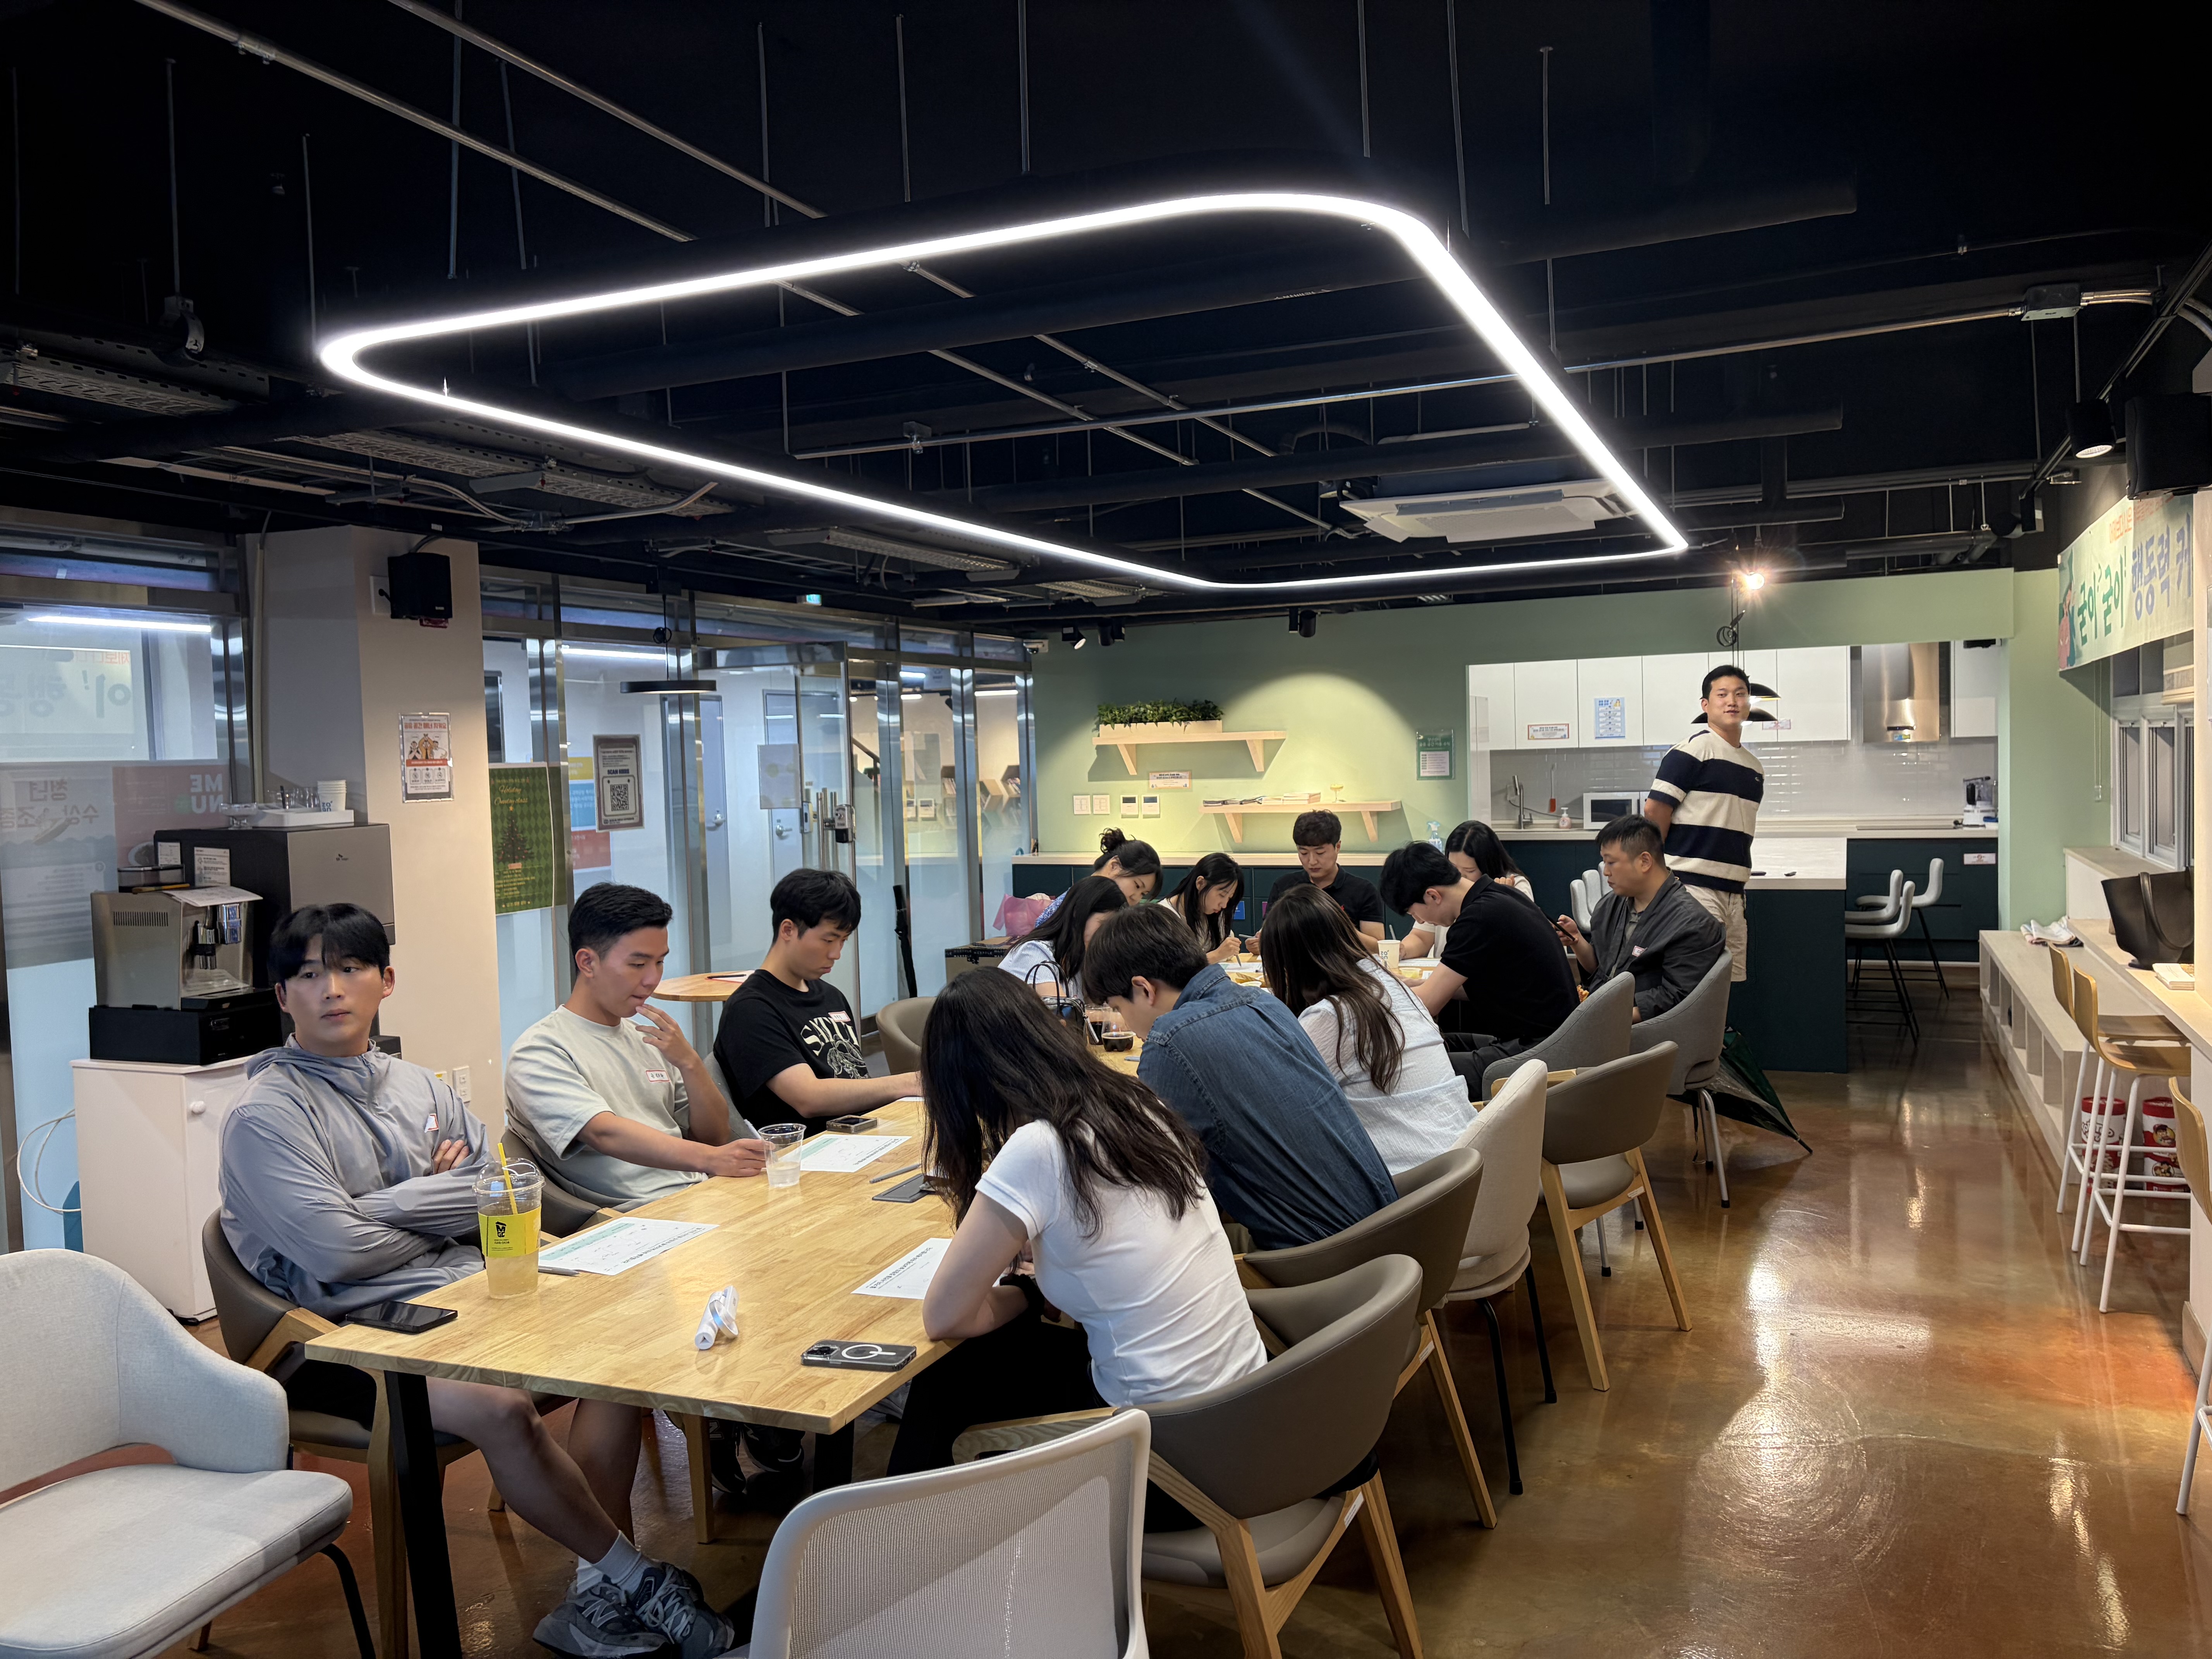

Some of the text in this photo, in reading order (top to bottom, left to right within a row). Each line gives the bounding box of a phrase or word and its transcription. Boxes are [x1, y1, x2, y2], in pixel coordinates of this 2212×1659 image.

[2077, 563, 2103, 646] 굳이?
[2102, 546, 2126, 637] 굳이!
[2131, 524, 2170, 620] 행동력
[499, 785, 521, 794] Holiday
